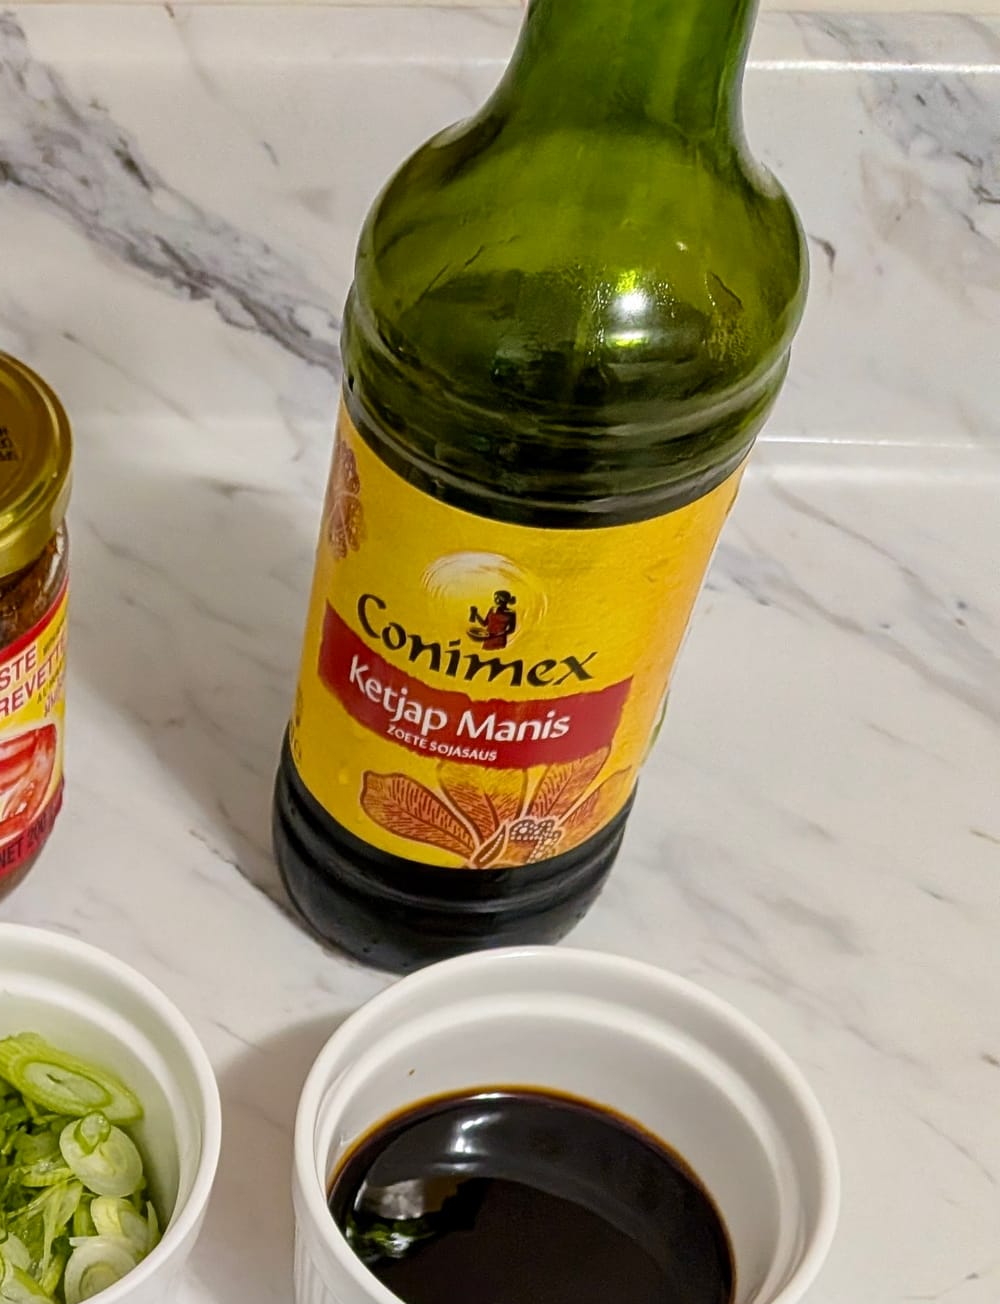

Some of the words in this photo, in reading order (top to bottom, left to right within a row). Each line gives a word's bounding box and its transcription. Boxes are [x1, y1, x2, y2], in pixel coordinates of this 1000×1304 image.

[357, 593, 598, 688] Conimex
[350, 655, 448, 736] Ketjap
[456, 711, 571, 742] Manis
[386, 725, 428, 750] ZOETE
[429, 740, 498, 761] SOJASAUS
